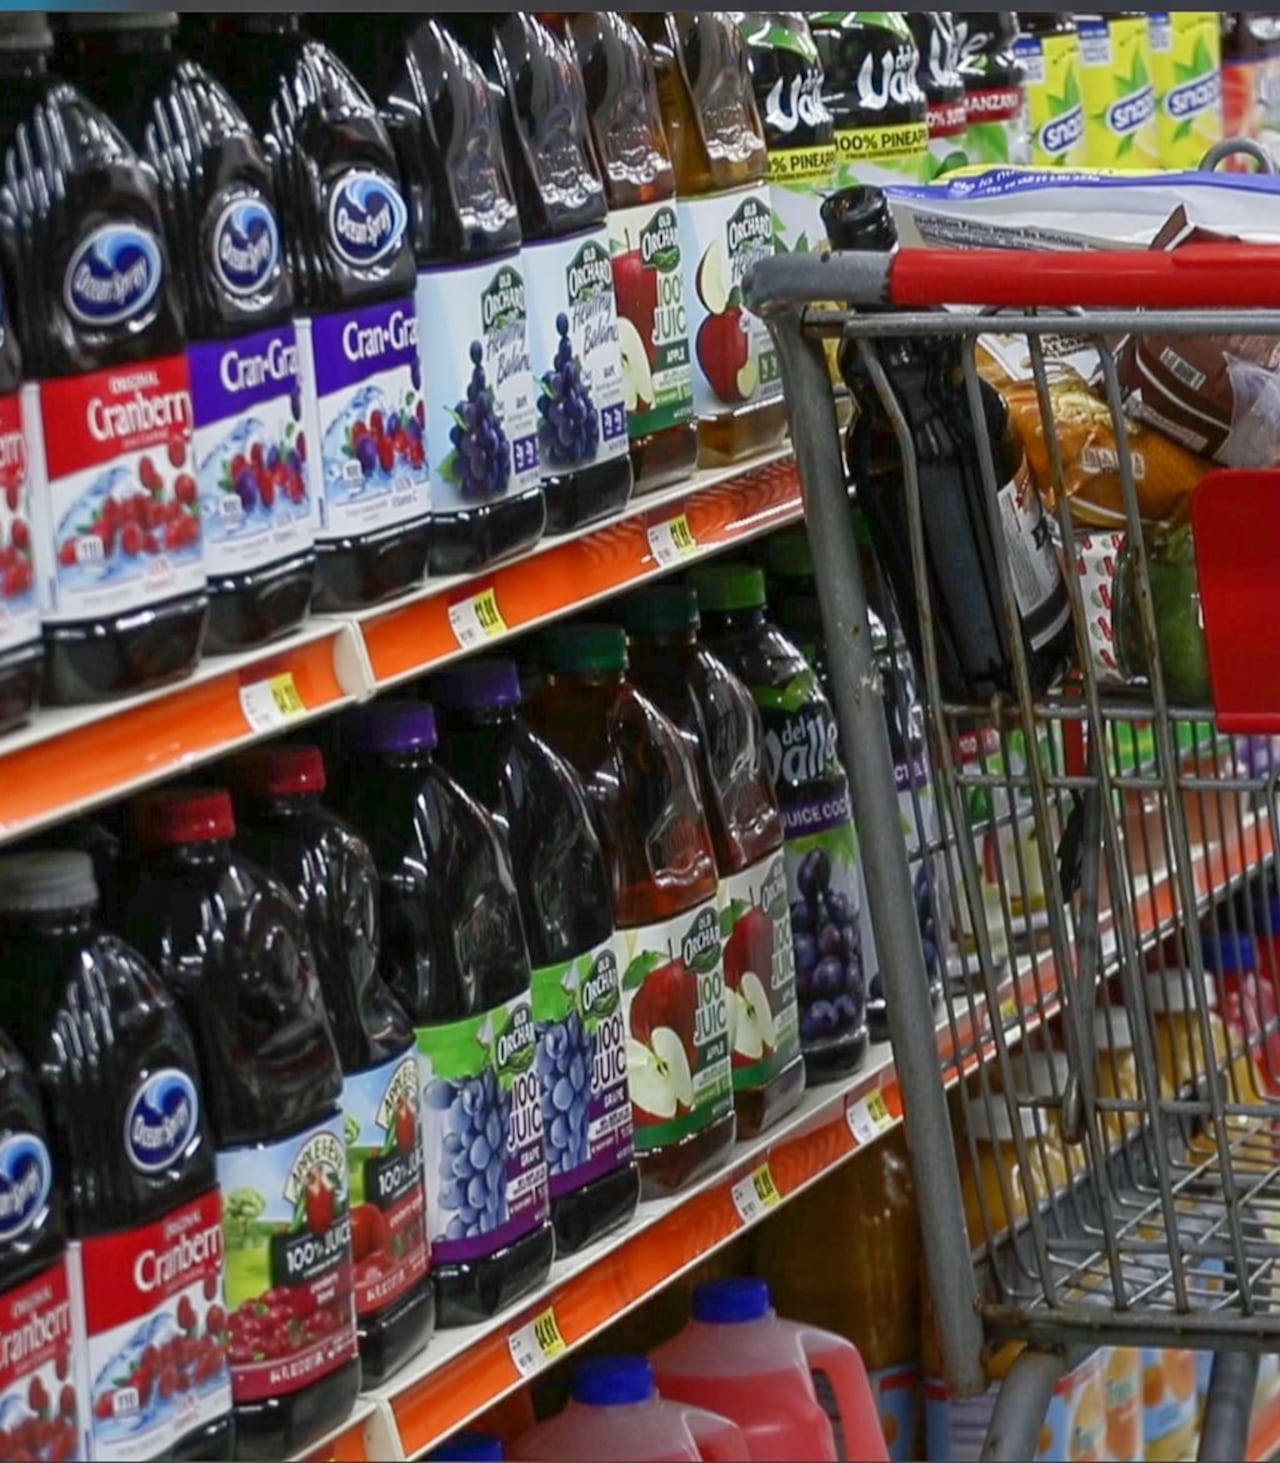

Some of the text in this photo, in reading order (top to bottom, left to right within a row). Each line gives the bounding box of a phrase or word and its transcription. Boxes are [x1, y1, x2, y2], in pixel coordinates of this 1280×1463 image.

[337, 202, 392, 248] Ocean Spray
[729, 213, 772, 250] ORCHARD
[221, 230, 270, 274] Ocean Spray
[75, 257, 148, 305] Ocean Spray
[569, 258, 612, 298] ORCHARD
[132, 1097, 190, 1149] Ocean Spray
